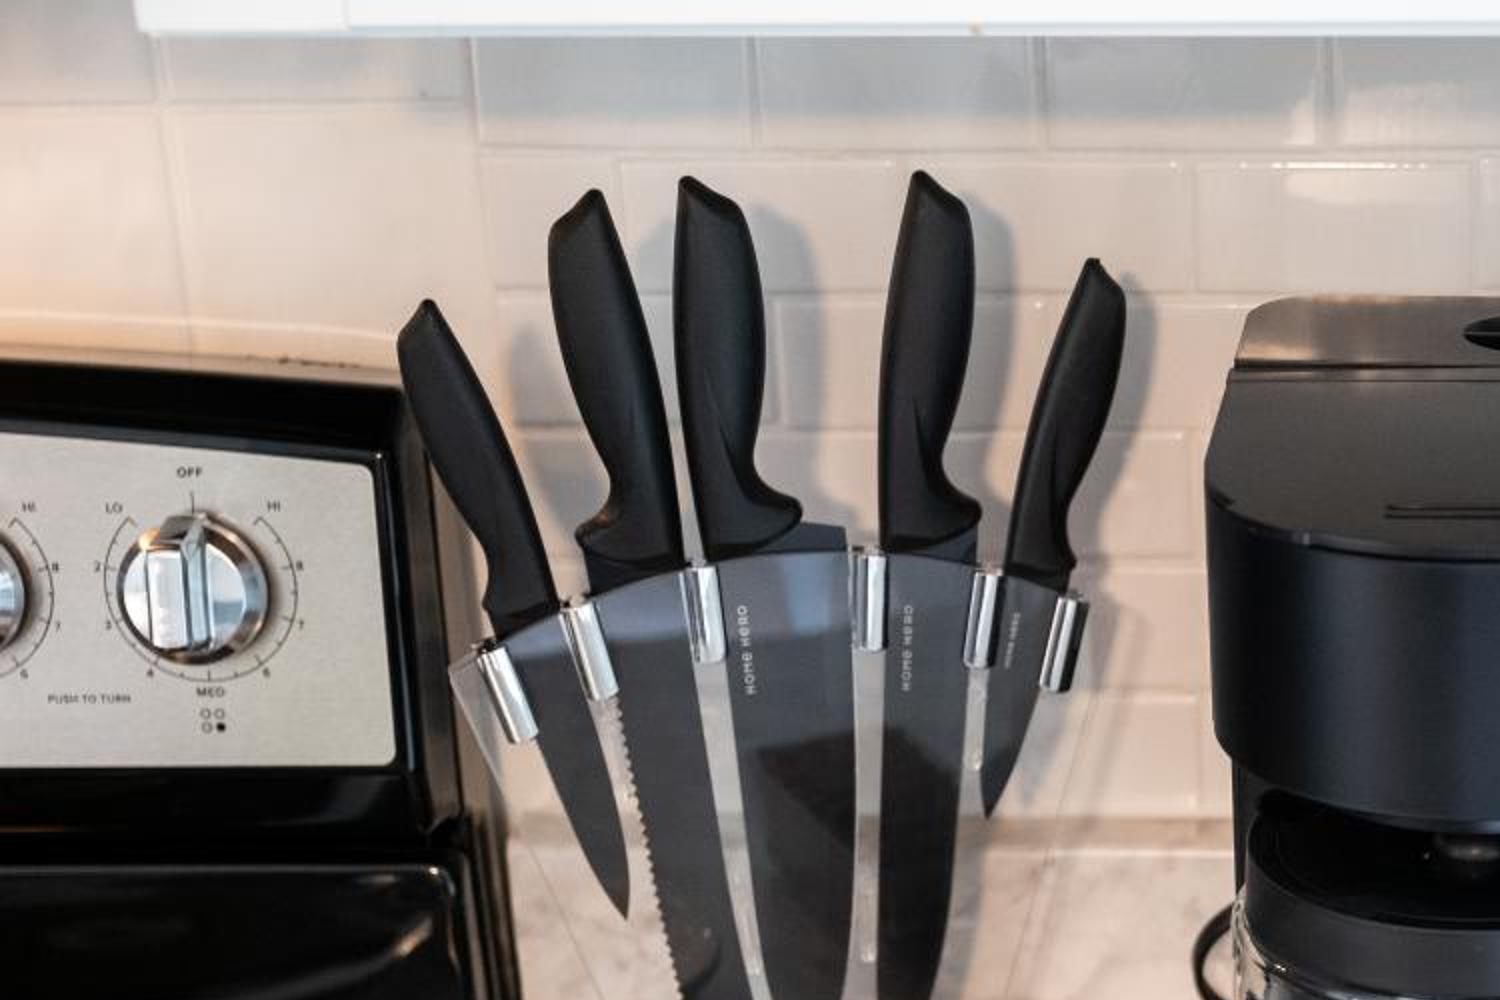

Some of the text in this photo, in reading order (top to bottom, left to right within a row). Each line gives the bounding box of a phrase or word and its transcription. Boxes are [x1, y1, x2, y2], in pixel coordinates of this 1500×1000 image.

[176, 466, 203, 479] OFF
[106, 502, 123, 514] LO
[267, 501, 281, 512] HI
[737, 604, 757, 695] HOME HERO
[196, 686, 225, 698] MED
